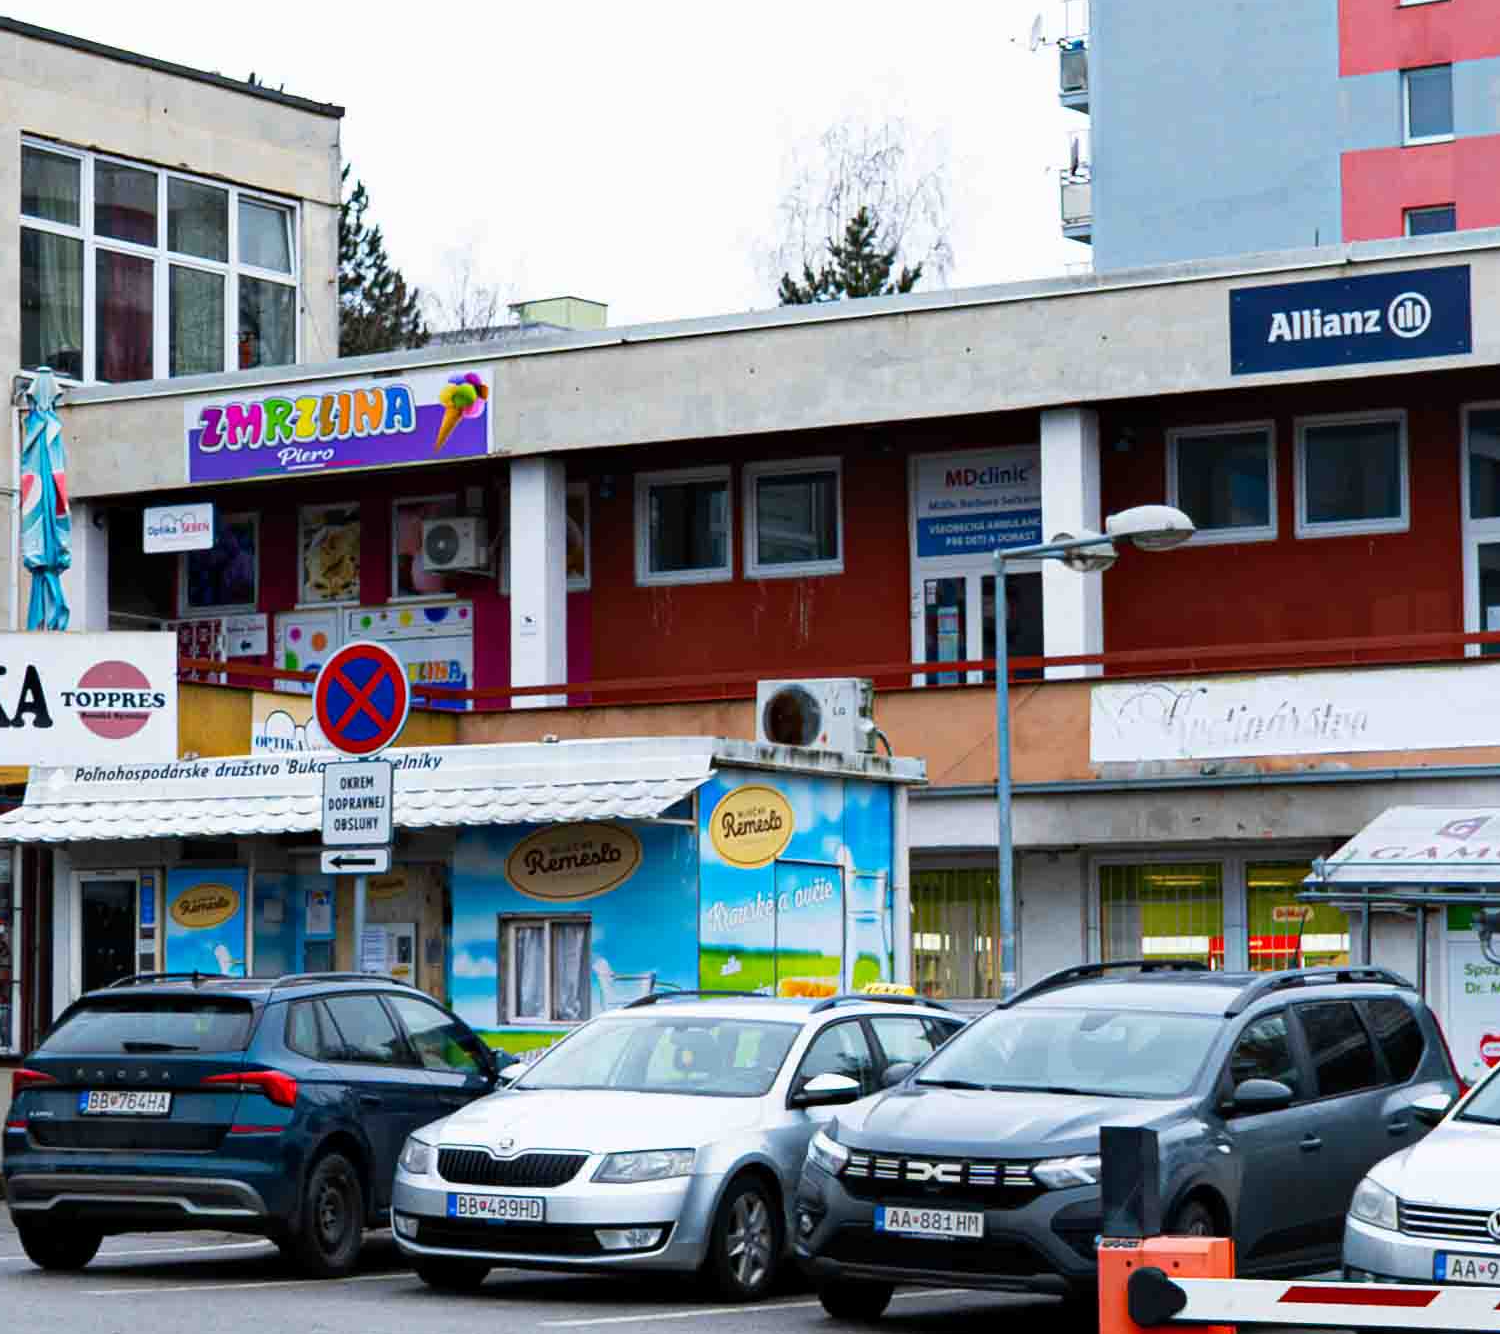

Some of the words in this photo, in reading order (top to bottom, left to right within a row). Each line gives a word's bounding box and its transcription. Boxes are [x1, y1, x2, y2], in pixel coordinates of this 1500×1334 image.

[1267, 308, 1382, 343] Allianz
[200, 384, 416, 451] ZMRZLINA
[277, 446, 335, 467] Piero
[945, 467, 1030, 488] MDclinic
[60, 689, 167, 709] TOPPRES
[215, 762, 279, 778] družstvo
[339, 776, 374, 790] OKREM
[328, 796, 385, 811] DOPRAVNEJ
[334, 817, 379, 832] OBSLUHY
[720, 812, 784, 840] Remeslo
[524, 844, 623, 875] Remeslo
[1464, 982, 1485, 994] Dr.
